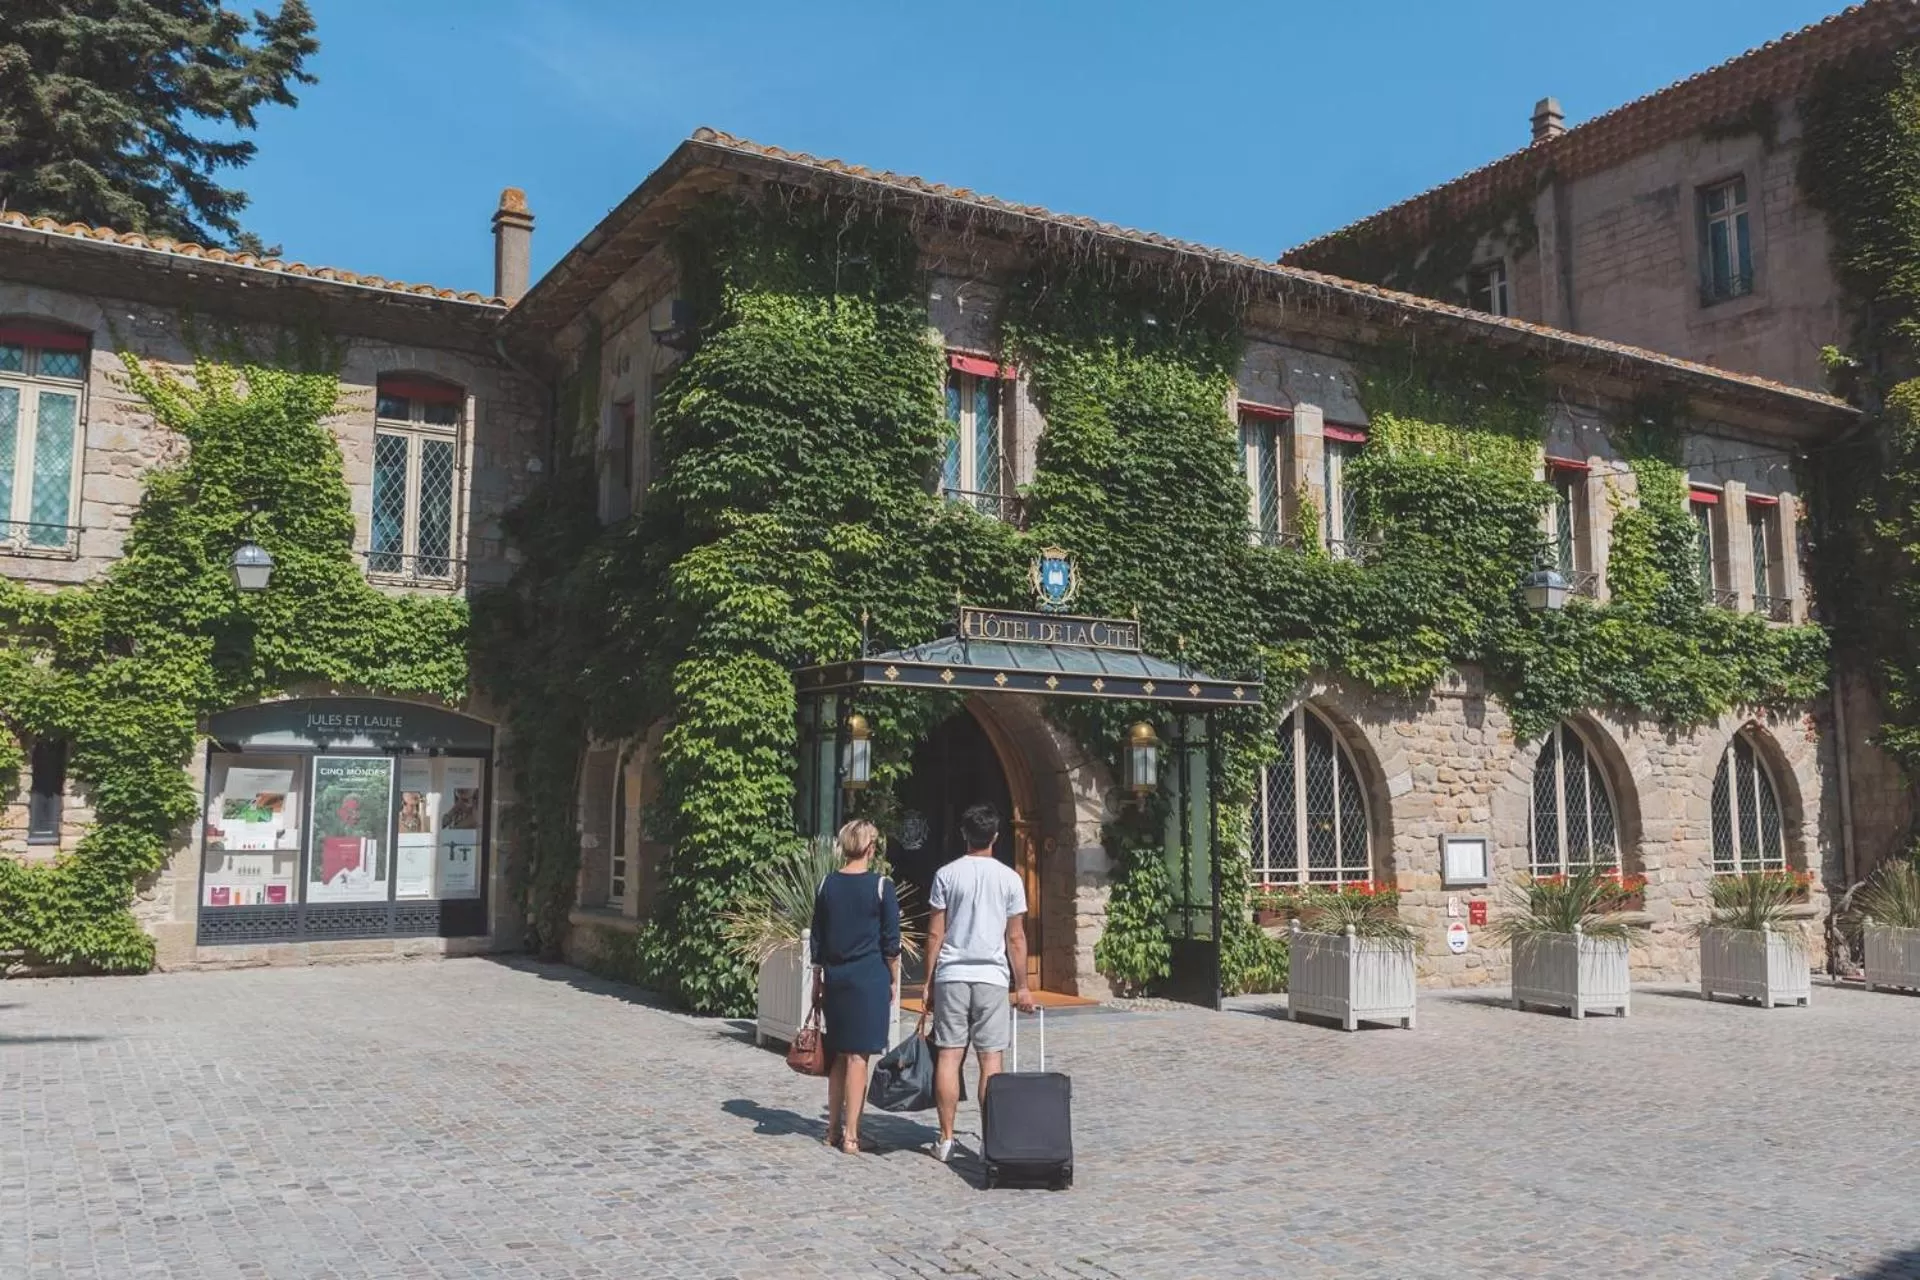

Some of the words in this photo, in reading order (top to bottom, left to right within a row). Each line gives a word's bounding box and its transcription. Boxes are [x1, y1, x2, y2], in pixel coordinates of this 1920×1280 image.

[964, 612, 1034, 640] HÔTEL
[1039, 623, 1063, 642] DE
[1066, 625, 1089, 645] LA
[306, 714, 341, 728] JULES
[345, 715, 361, 726] ET
[364, 716, 403, 727] LAULE
[320, 767, 344, 776] CINQ
